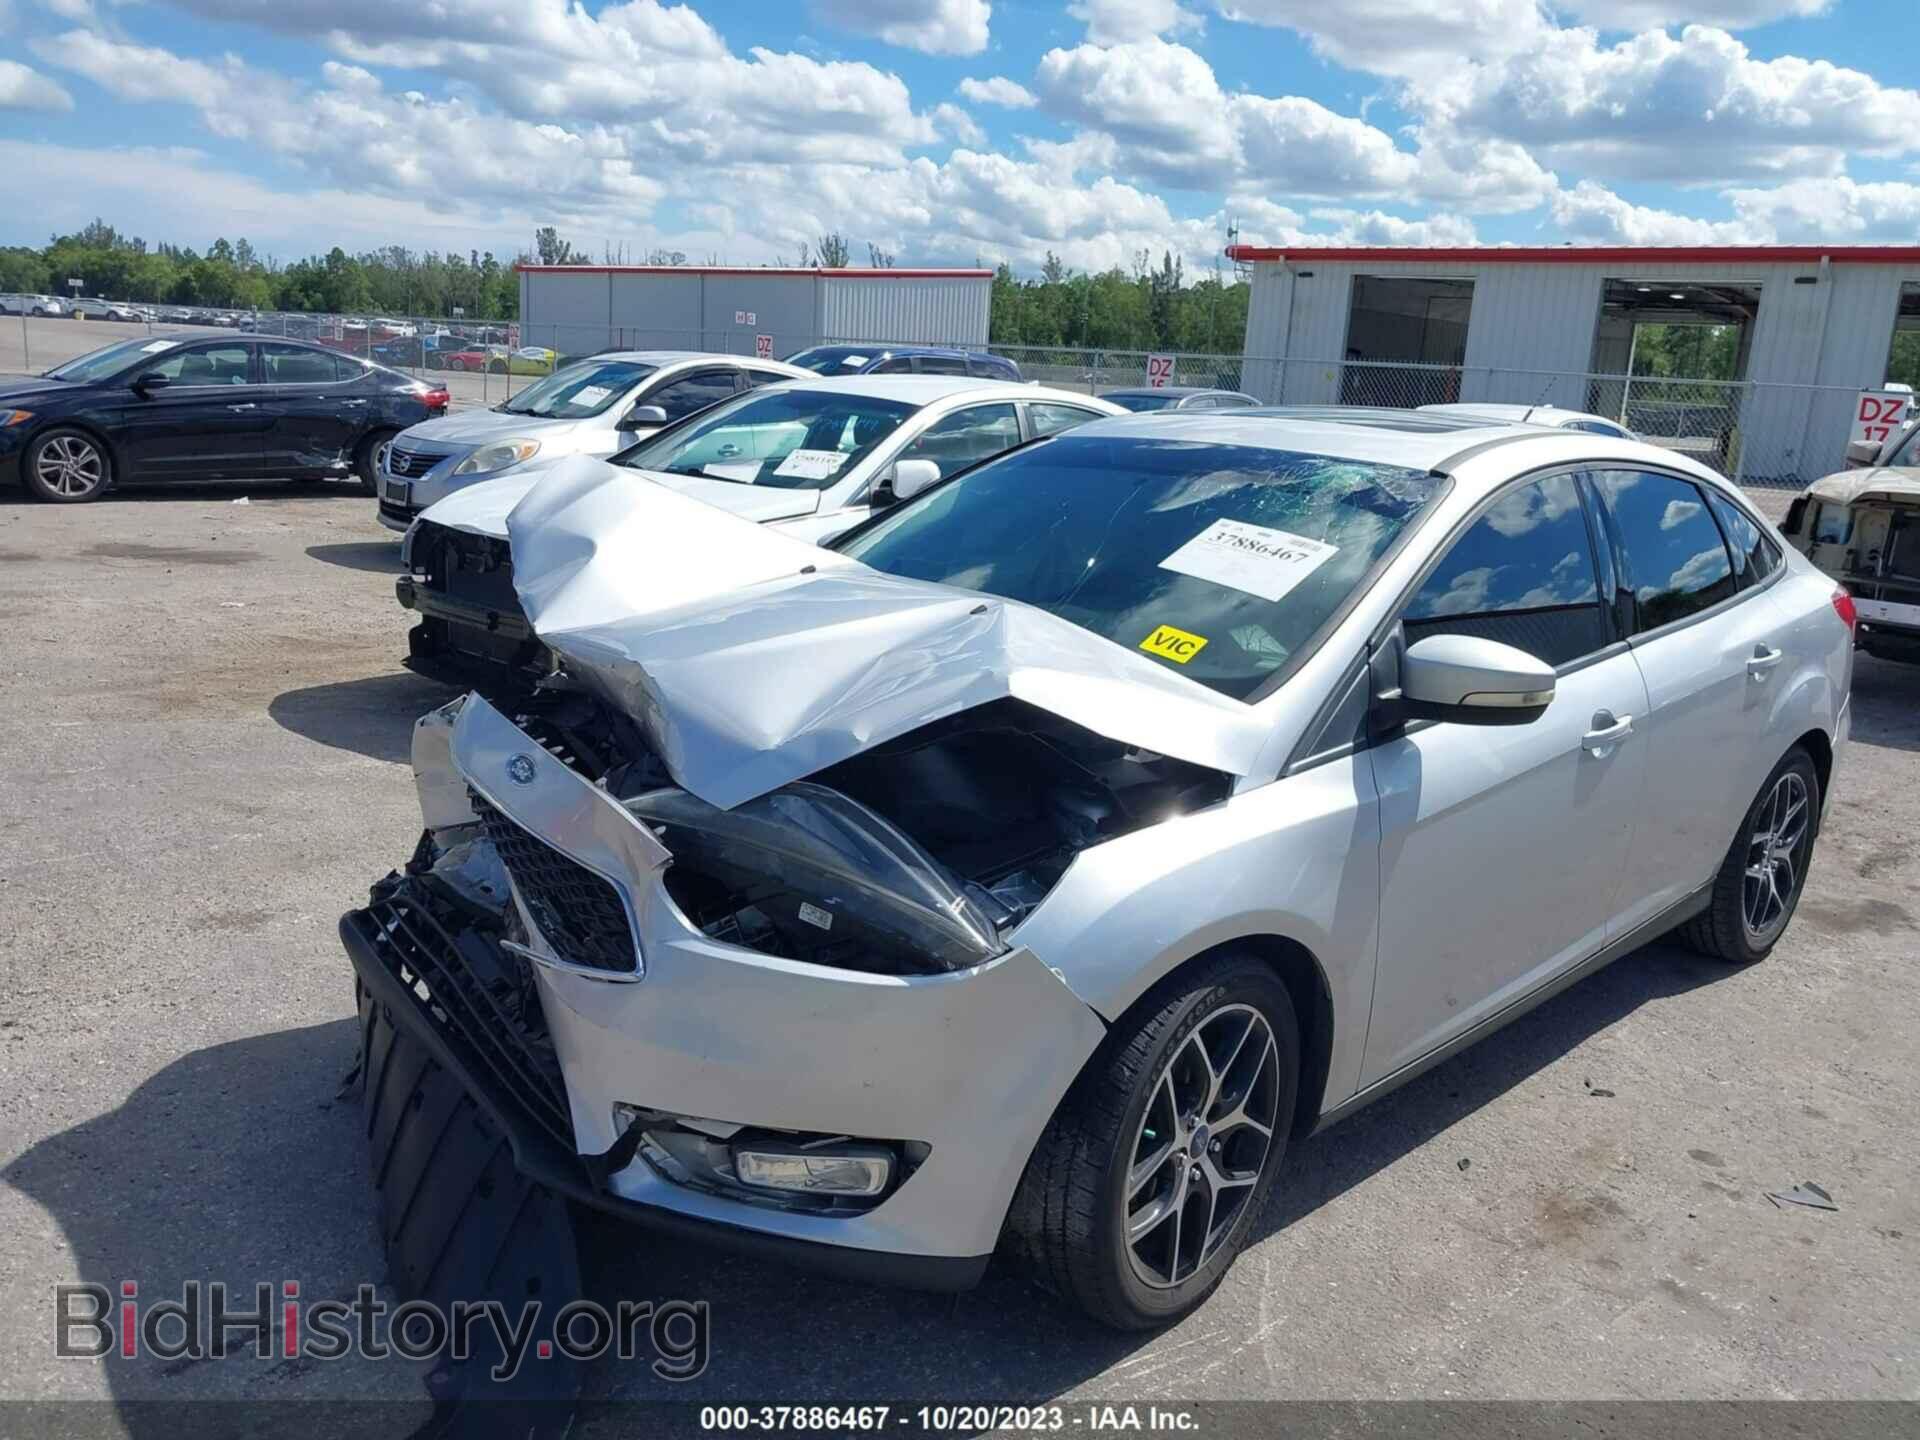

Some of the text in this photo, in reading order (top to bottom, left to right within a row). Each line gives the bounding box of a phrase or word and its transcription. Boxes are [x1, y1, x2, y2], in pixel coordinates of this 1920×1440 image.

[758, 337, 771, 352] DZ
[1149, 359, 1173, 377] DZ
[1859, 397, 1904, 424] DZ
[1864, 426, 1889, 442] 17
[1208, 532, 1310, 563] 37886467
[1154, 632, 1196, 656] VIC
